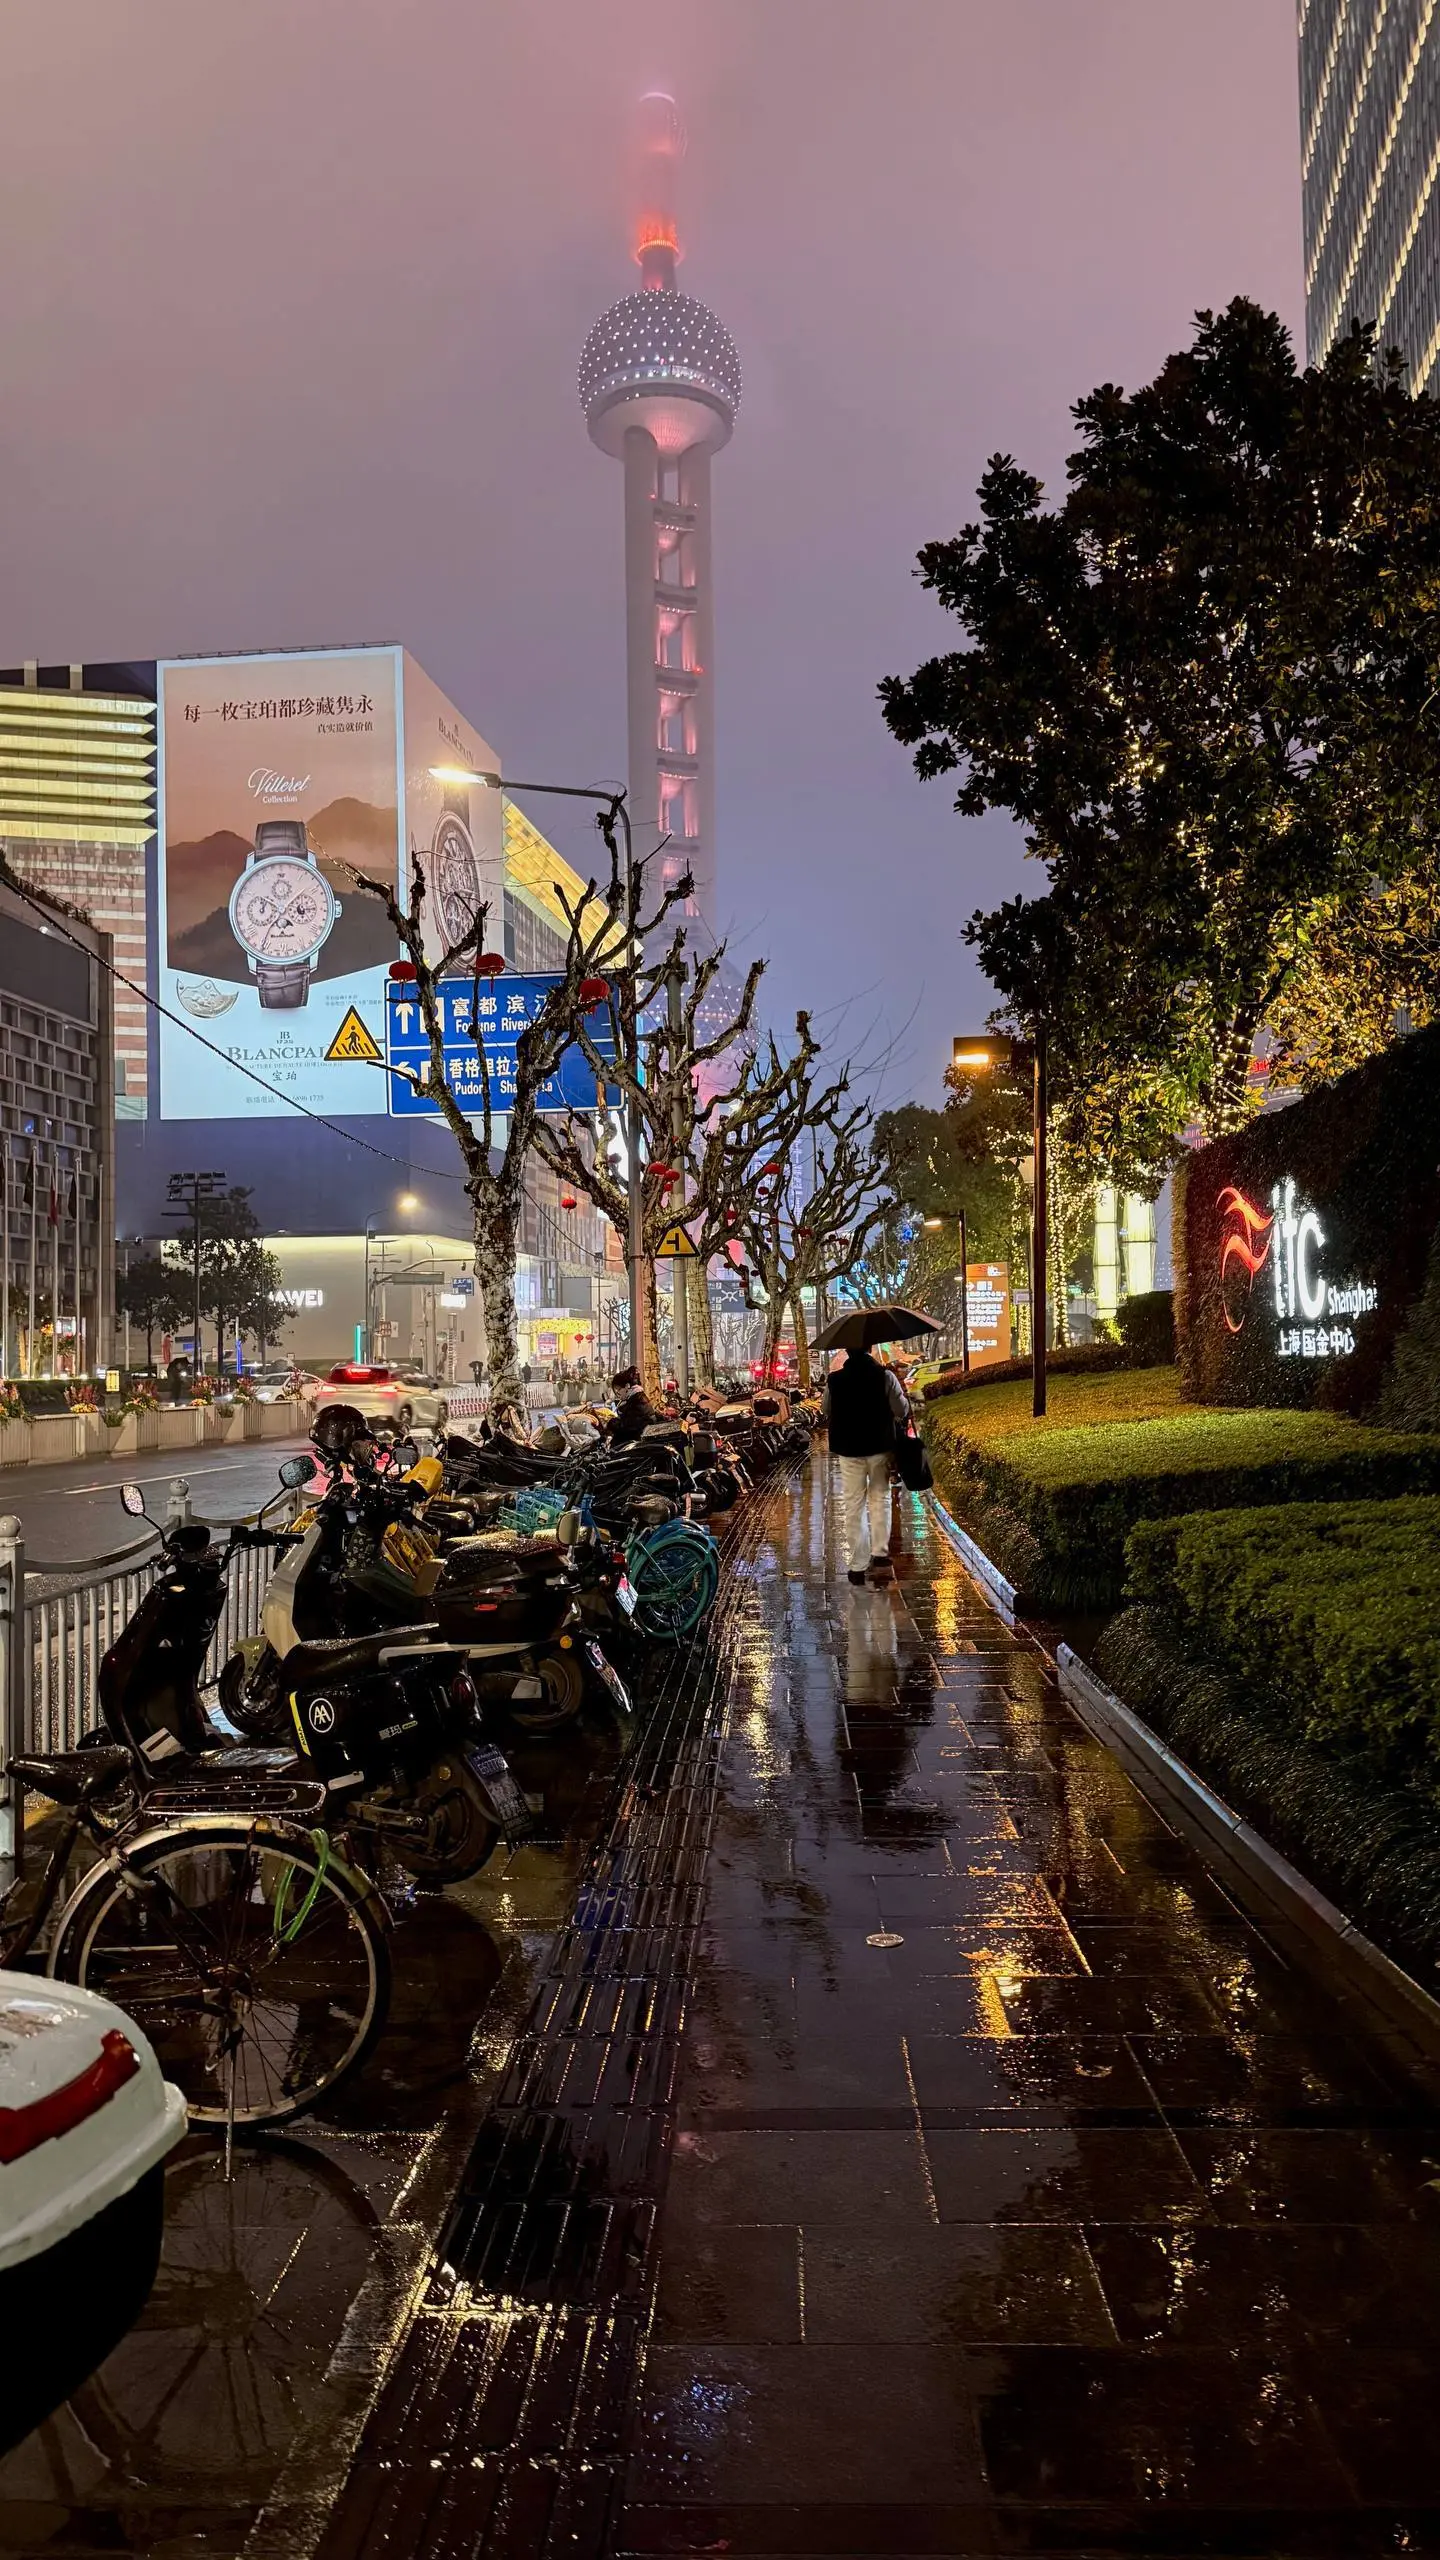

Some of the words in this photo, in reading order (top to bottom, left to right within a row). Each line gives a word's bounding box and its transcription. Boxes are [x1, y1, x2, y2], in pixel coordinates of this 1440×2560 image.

[184, 695, 373, 723] 每一枚宝珀都珍藏隽永
[317, 721, 373, 733] 真实造就价值
[247, 767, 311, 798] Villeret
[262, 794, 298, 804] Collection
[226, 1045, 327, 1061] BLANCPAI
[272, 1069, 297, 1082] 宝珀
[1327, 1280, 1378, 1320] Shanghai
[1278, 1326, 1356, 1357] 上海国金中心
